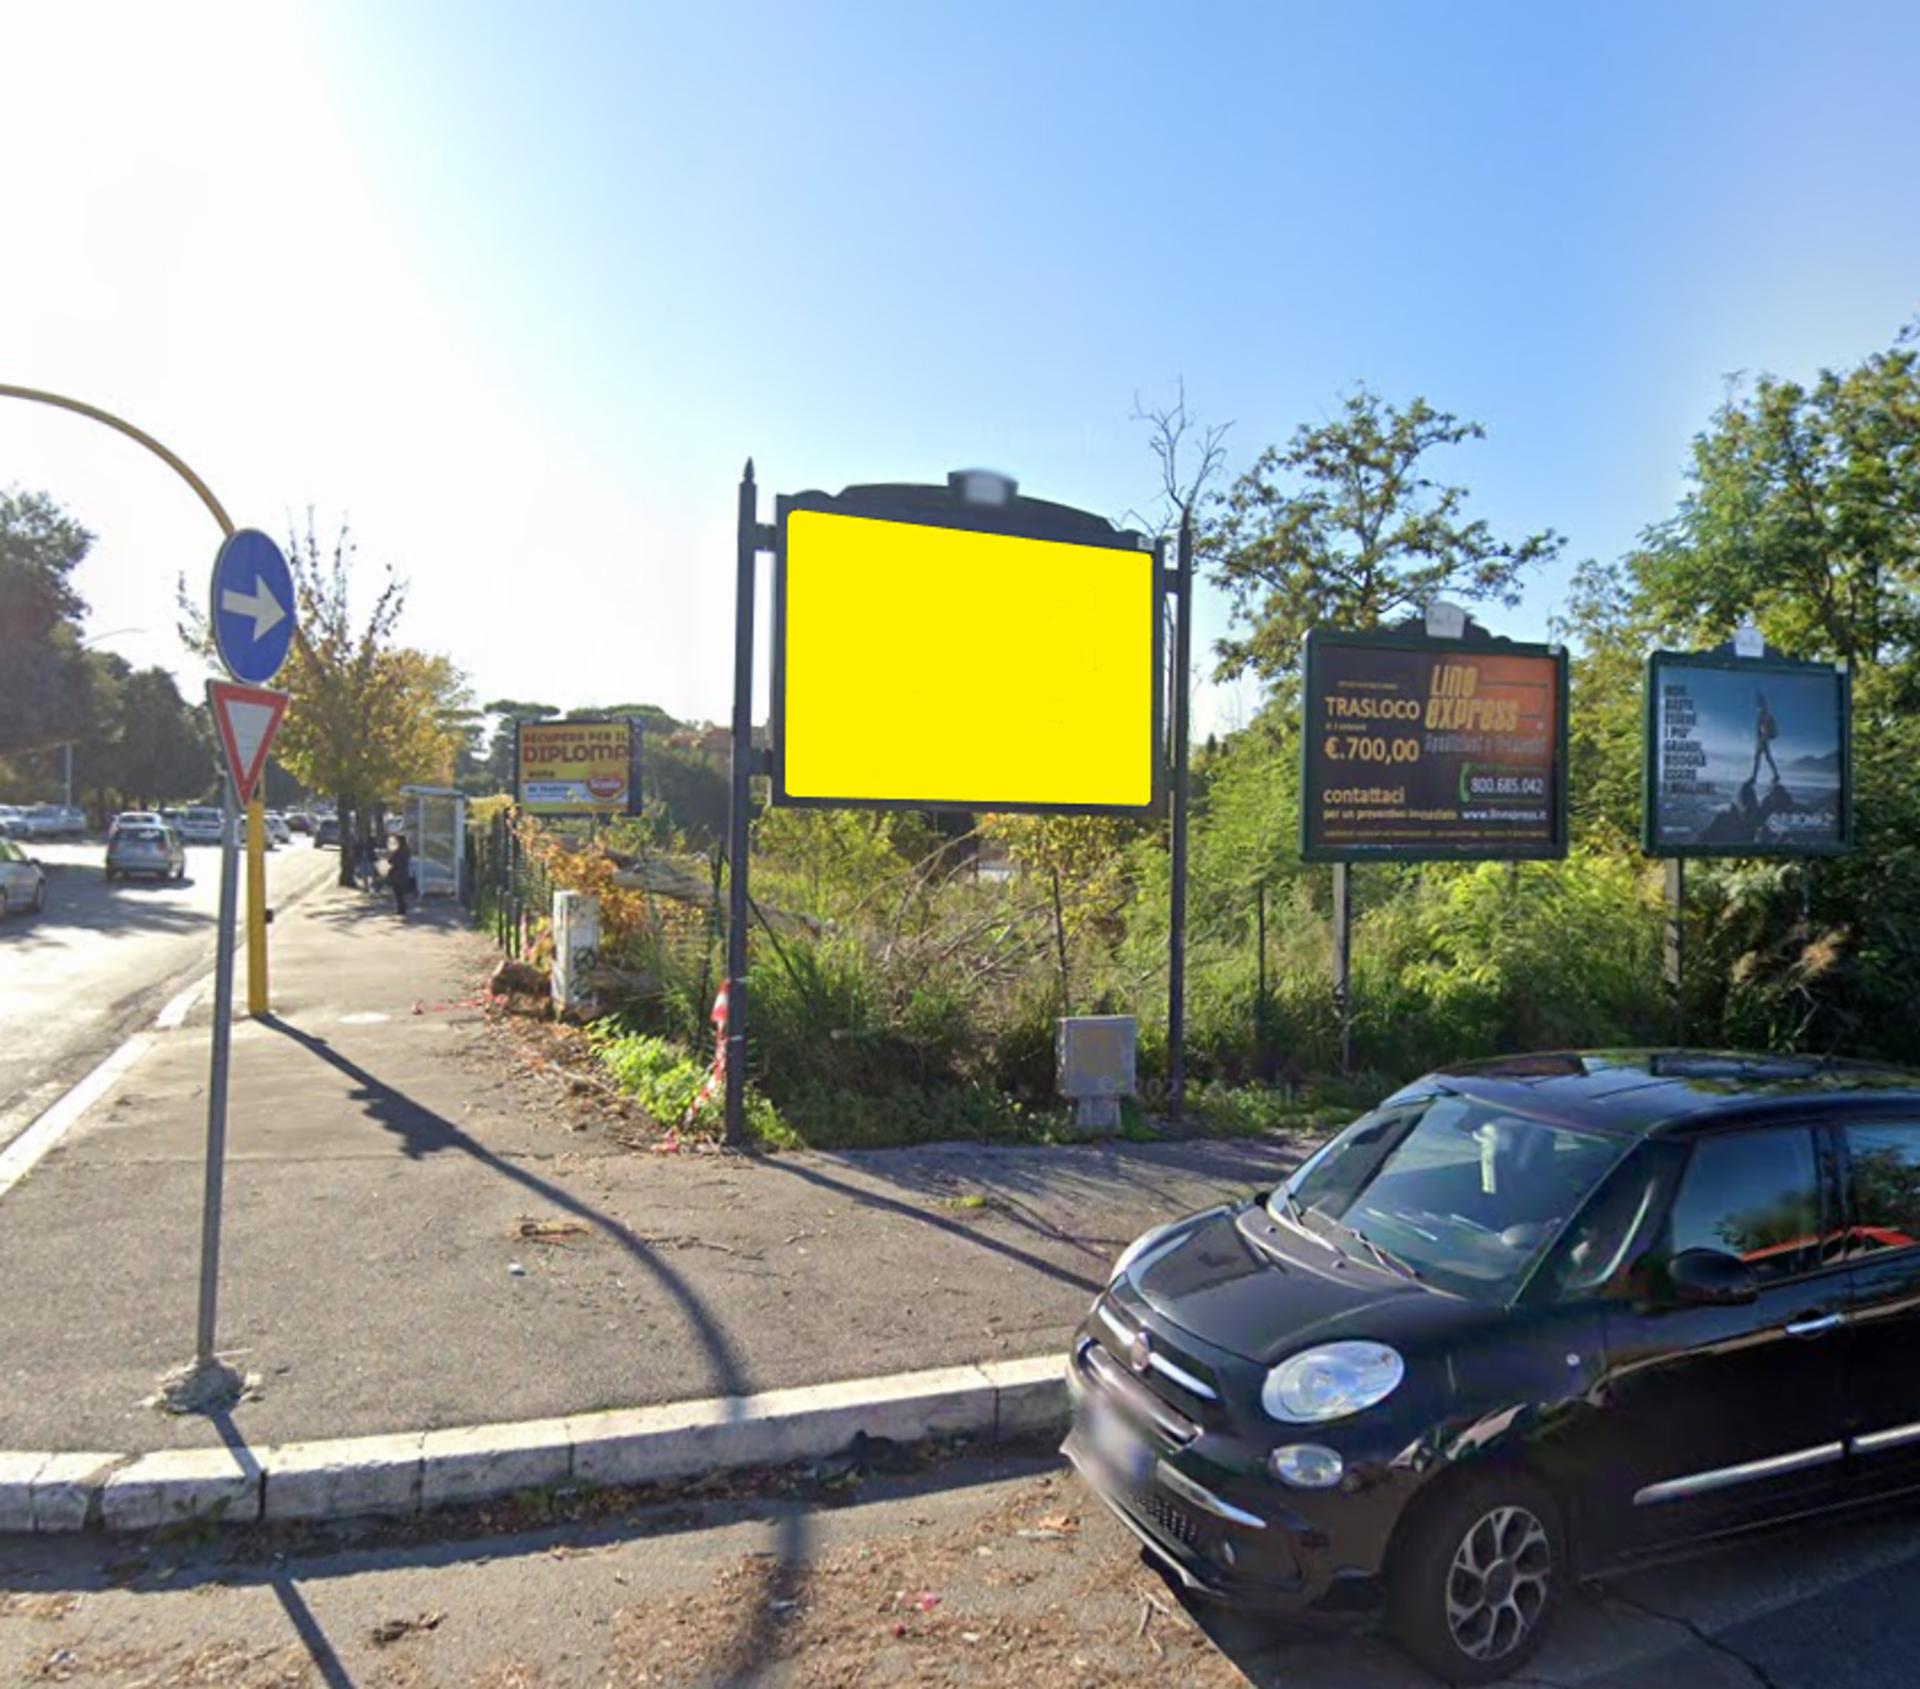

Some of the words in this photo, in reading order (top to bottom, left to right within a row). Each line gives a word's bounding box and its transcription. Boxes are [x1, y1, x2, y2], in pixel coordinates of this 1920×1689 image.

[1325, 696, 1420, 719] TRASLOCO
[523, 743, 630, 763] DIPLOMA
[1325, 736, 1420, 765] €.700,00
[1323, 785, 1406, 804] contattaci
